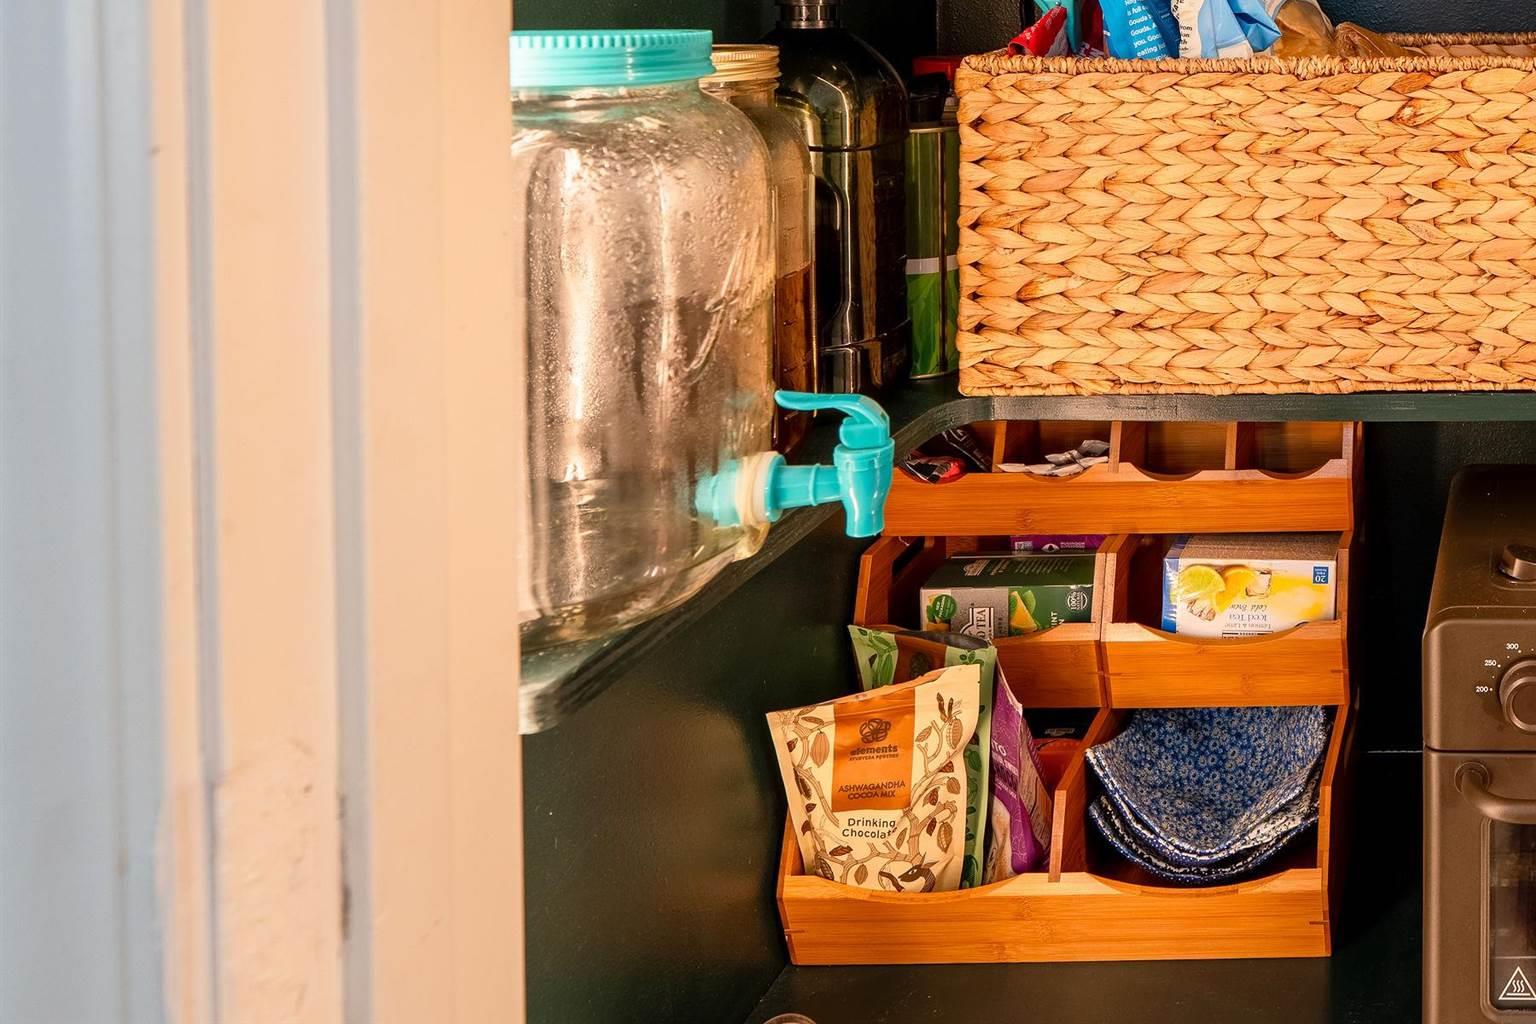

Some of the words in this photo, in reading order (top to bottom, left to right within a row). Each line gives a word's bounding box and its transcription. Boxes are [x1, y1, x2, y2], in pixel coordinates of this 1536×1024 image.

[1128, 15, 1148, 26] Gouda
[1136, 46, 1158, 57] eating
[1315, 575, 1327, 584] 20
[1069, 590, 1078, 611] 100%
[976, 608, 987, 630] TEA
[1228, 614, 1244, 622] Tea
[1247, 614, 1268, 622] Iced
[1506, 643, 1519, 651] 300
[1484, 659, 1497, 667] 250
[1475, 685, 1489, 693] 200
[850, 743, 899, 756] elements
[838, 779, 906, 793] ASHWAGANDHA
[847, 791, 880, 801] COCOA
[880, 789, 897, 799] MIX
[847, 817, 897, 829] Drinking
